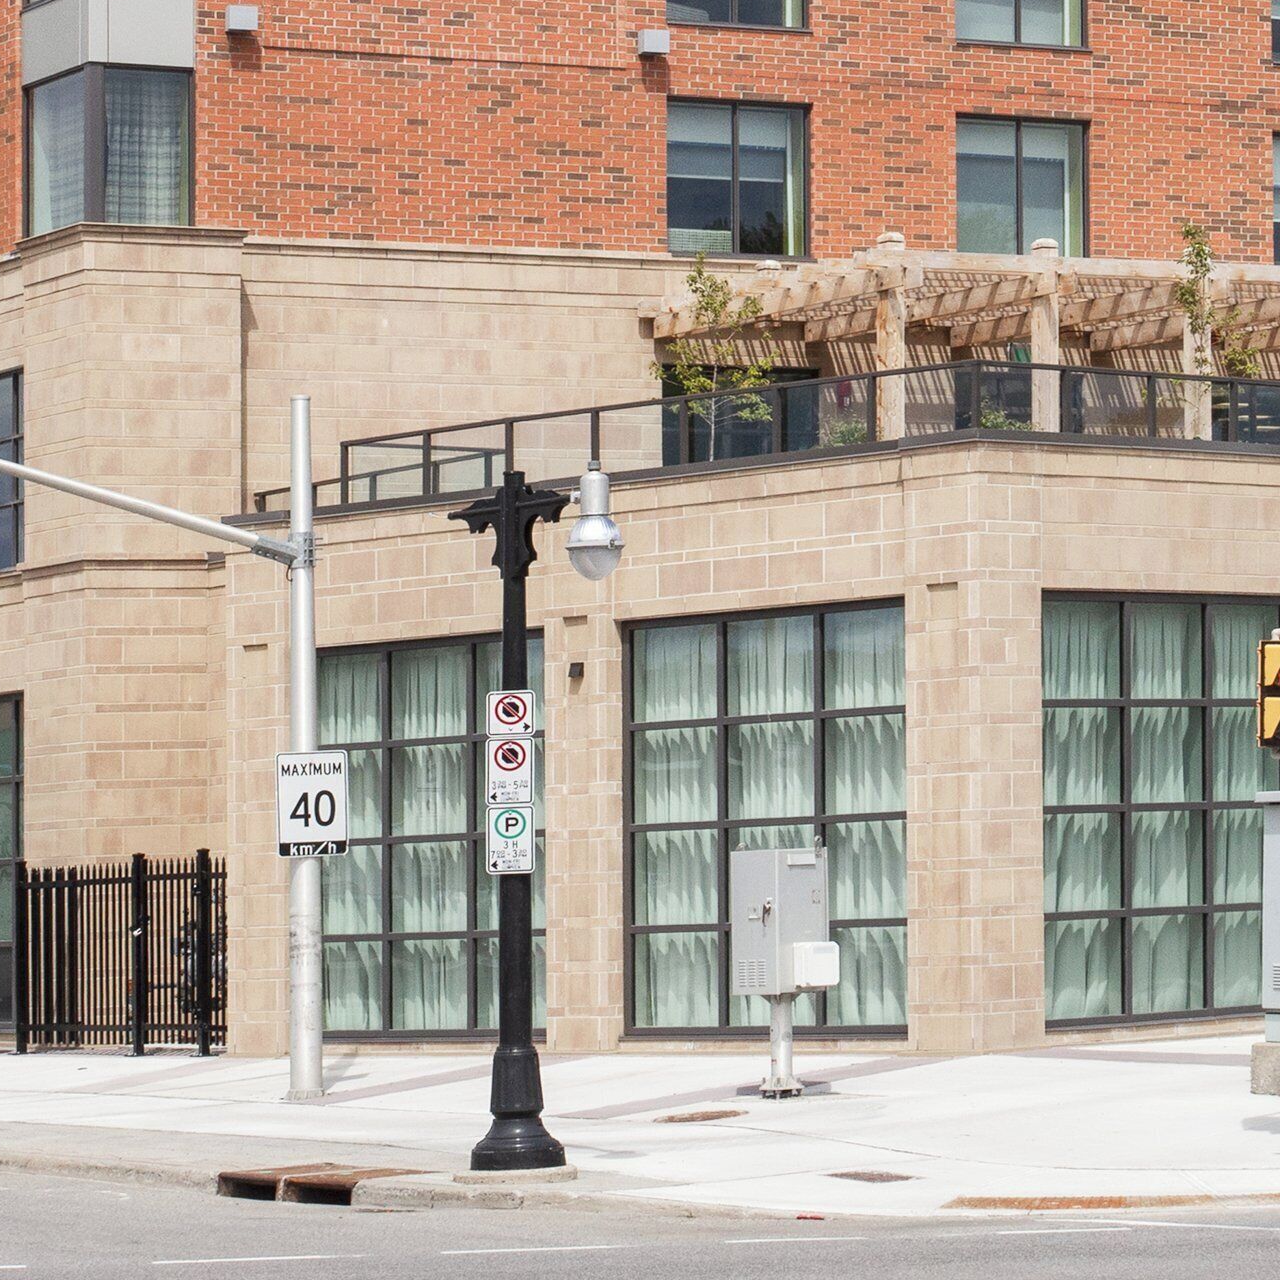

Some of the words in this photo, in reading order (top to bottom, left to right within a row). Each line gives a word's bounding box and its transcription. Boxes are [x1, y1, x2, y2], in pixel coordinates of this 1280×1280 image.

[281, 762, 342, 776] MAXIMUM
[290, 790, 336, 827] 40
[290, 841, 337, 855] km/h
